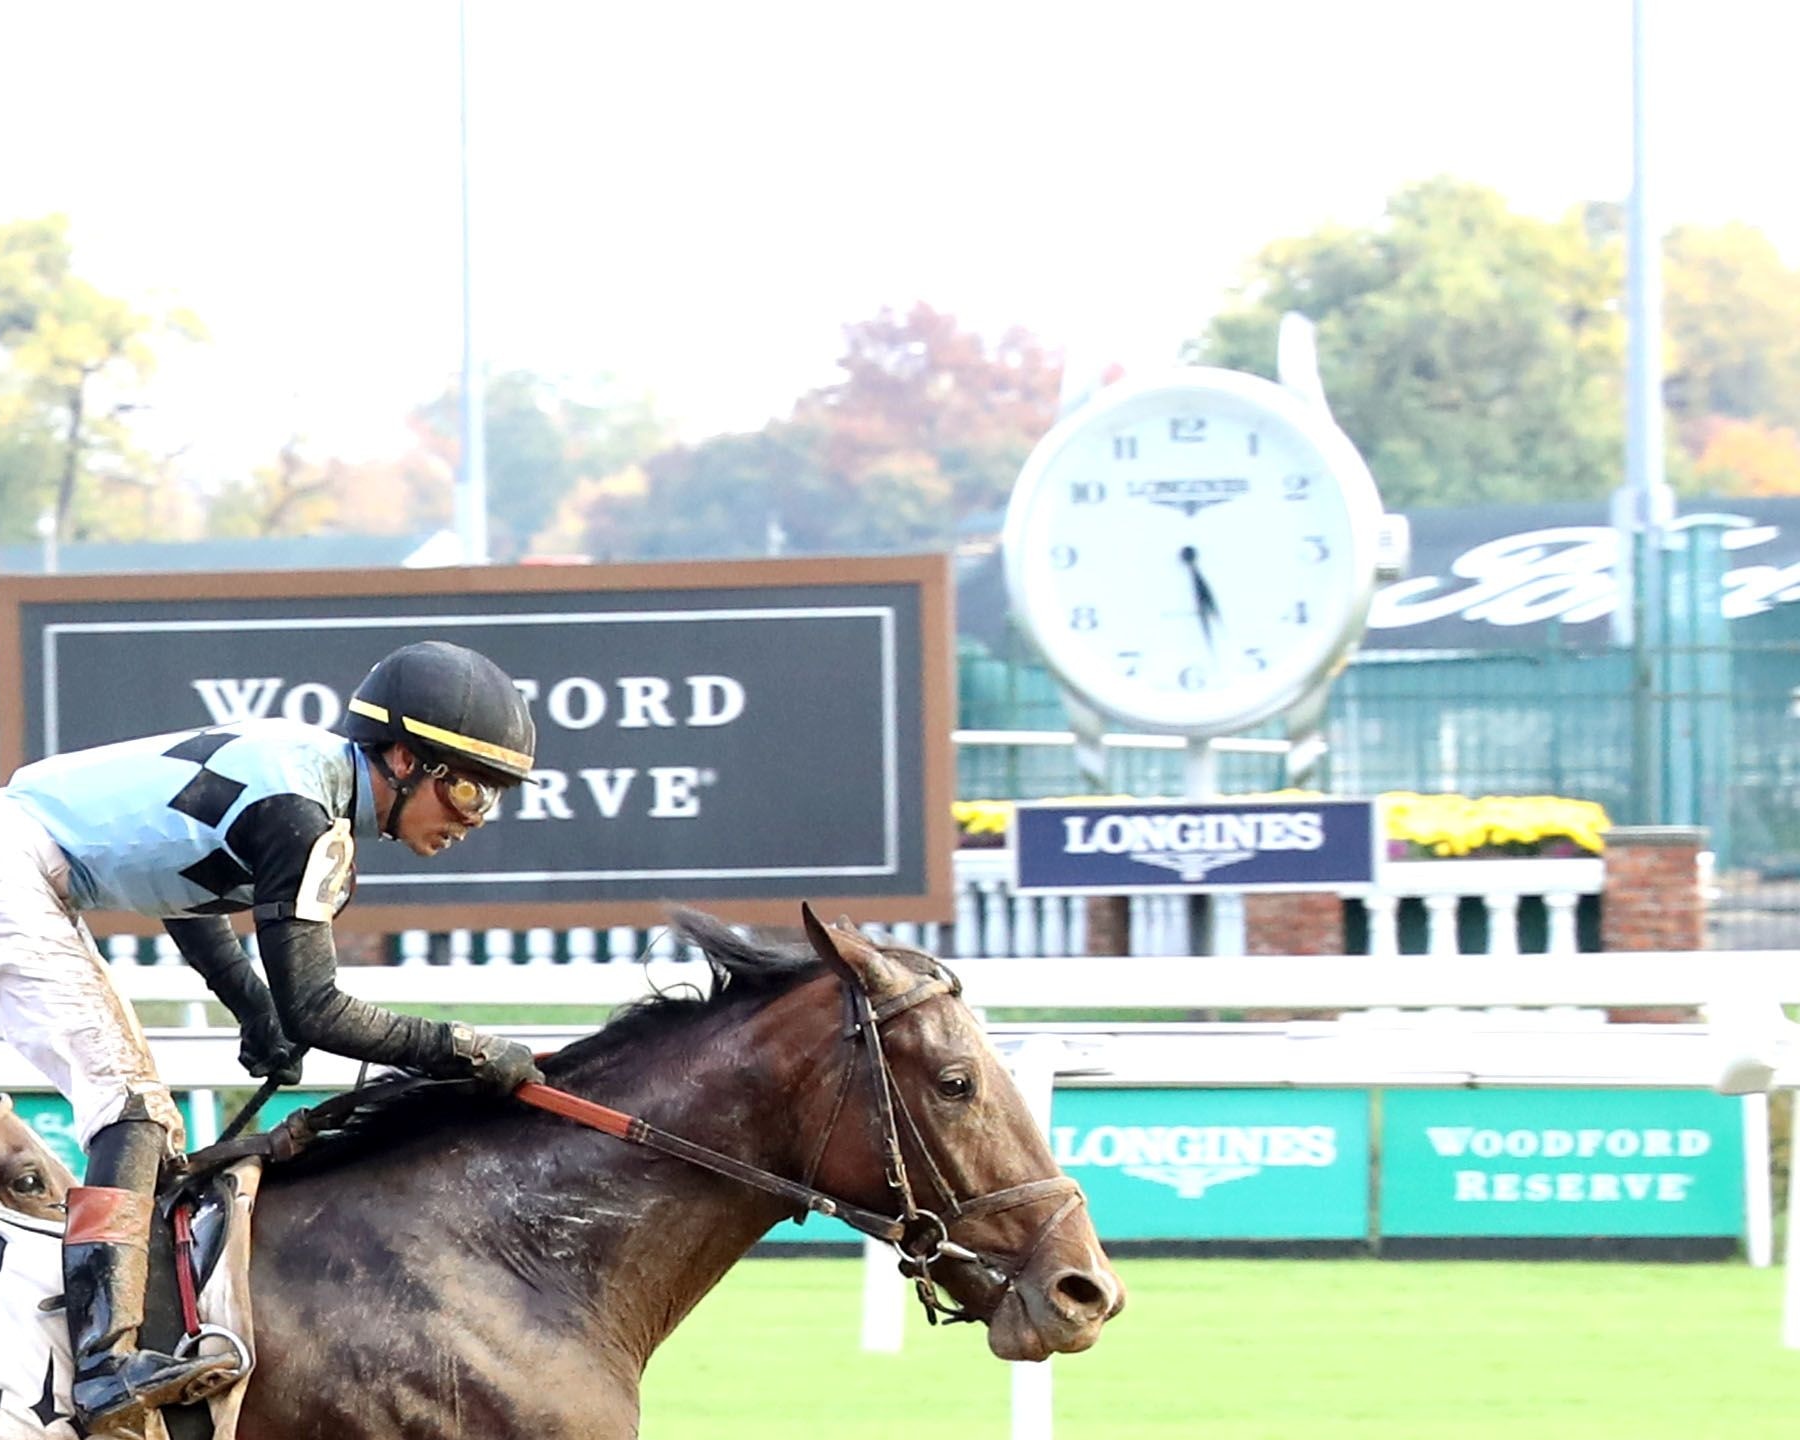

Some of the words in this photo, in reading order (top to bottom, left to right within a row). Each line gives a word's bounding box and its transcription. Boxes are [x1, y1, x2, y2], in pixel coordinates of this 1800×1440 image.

[1169, 417, 1207, 442] 12
[1114, 436, 1138, 459] 11
[1248, 433, 1259, 456] 1
[1070, 481, 1105, 503] 10
[1285, 475, 1309, 500] 2
[1050, 545, 1078, 570] 9
[1302, 536, 1330, 565] 3
[1070, 607, 1098, 631] 8
[1281, 601, 1308, 624] 4
[1243, 648, 1267, 670] 5
[1178, 666, 1205, 690] 6
[192, 673, 746, 729] WOORD
[1063, 812, 1324, 854] LONGINES
[316, 841, 345, 904] 2
[1053, 1125, 1337, 1167] LONGINES
[1426, 1126, 1712, 1158] WOODFORD
[1454, 1171, 1688, 1202] RESERVE
